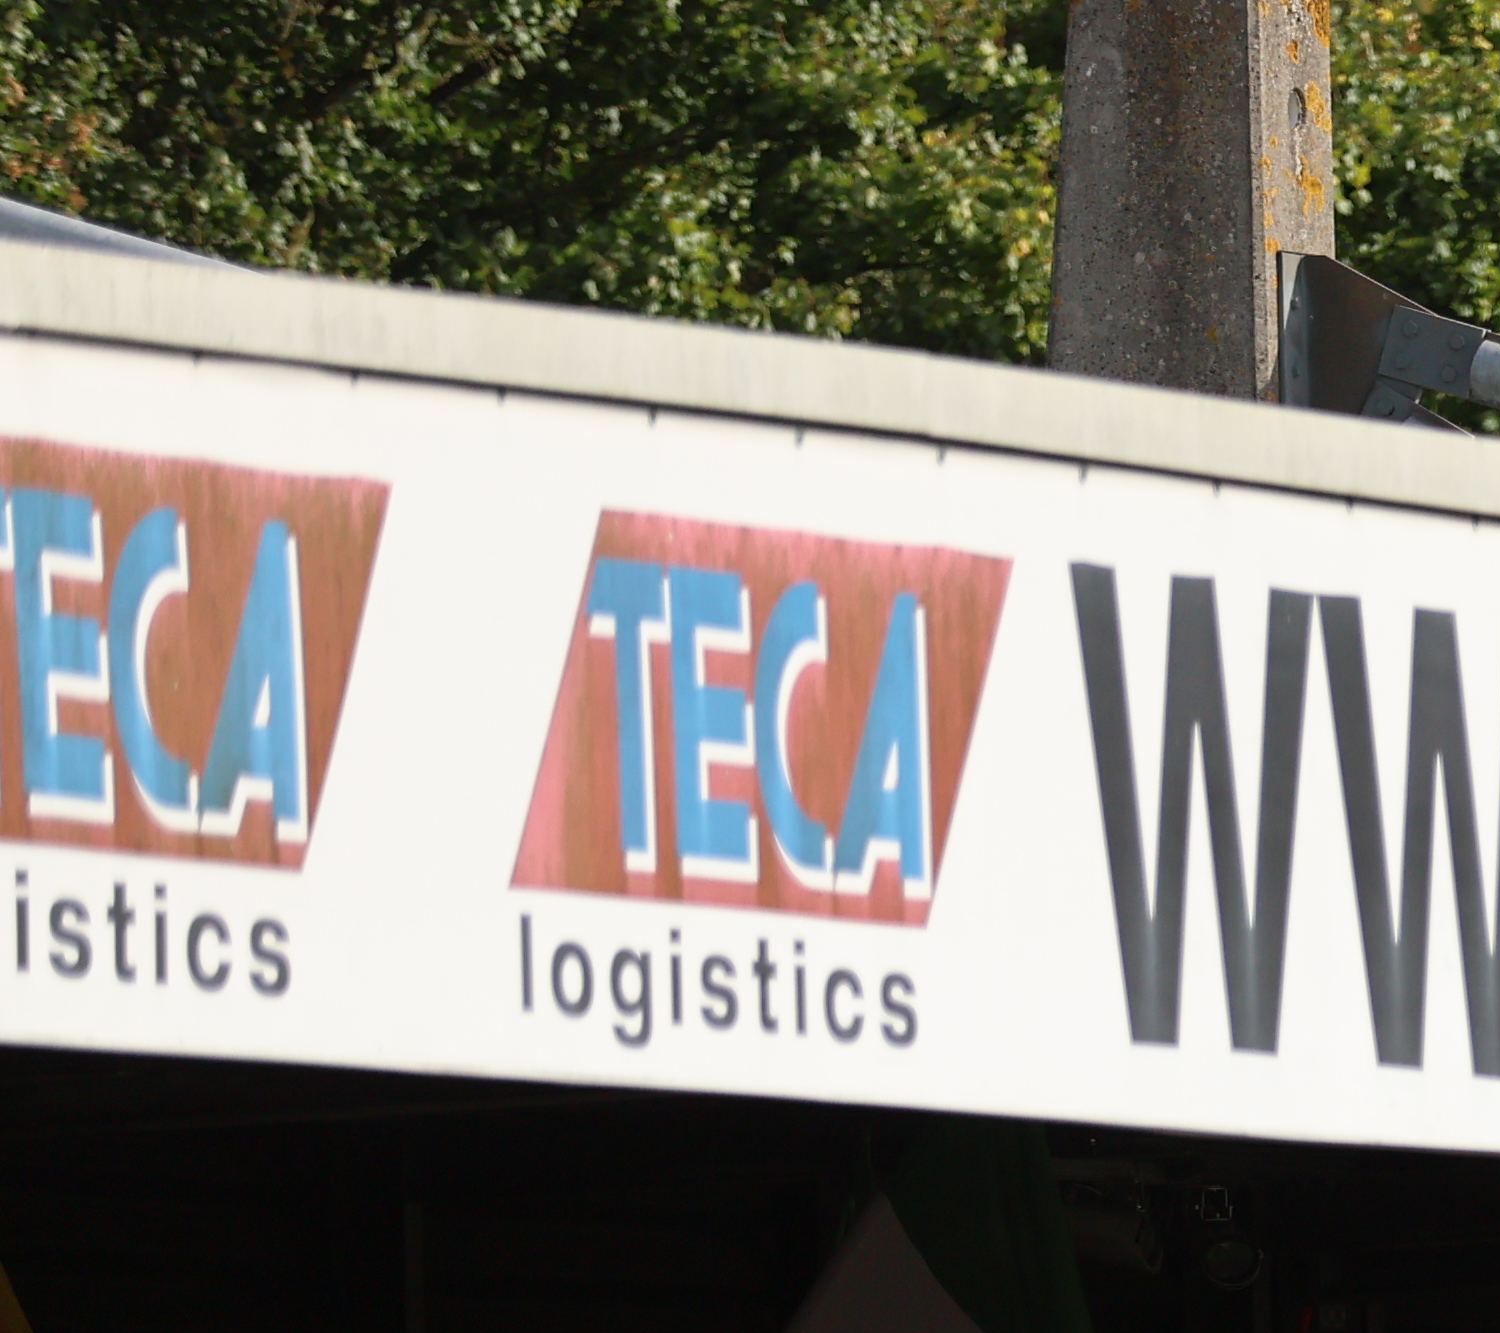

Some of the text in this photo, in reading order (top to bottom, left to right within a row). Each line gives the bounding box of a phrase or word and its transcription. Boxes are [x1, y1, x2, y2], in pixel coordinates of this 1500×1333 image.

[0, 484, 308, 843] ECA
[587, 557, 932, 900] TECA
[520, 914, 919, 1049] logistics
